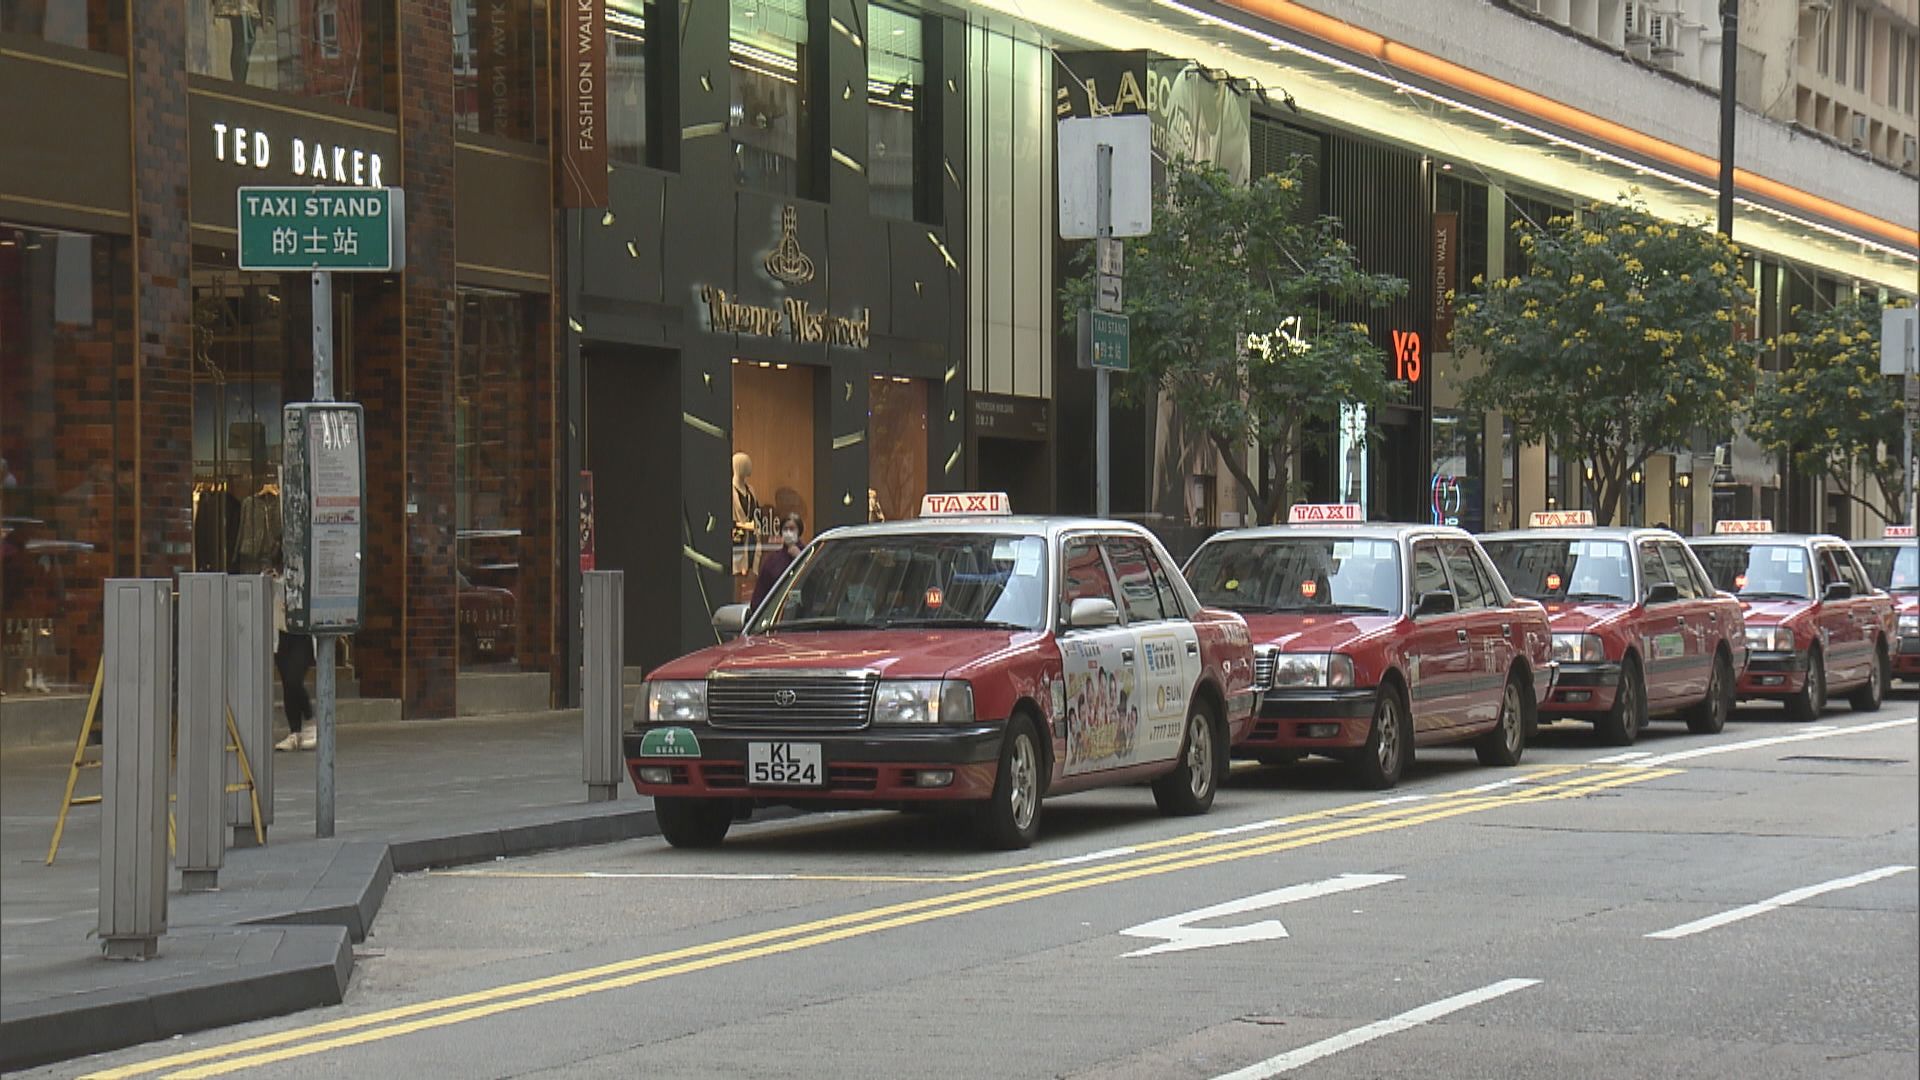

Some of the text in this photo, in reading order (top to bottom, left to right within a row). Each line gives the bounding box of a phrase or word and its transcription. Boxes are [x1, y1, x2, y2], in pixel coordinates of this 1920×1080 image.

[578, 0, 593, 151] FASHION WALK
[213, 123, 383, 189] TED BAKER
[246, 197, 382, 217] TAXI STAND
[272, 226, 358, 256] 的士站
[1436, 228, 1447, 320] FASHION WALK
[701, 283, 870, 349] Vivienne Westwood
[1094, 316, 1127, 337] TAXI STAND
[927, 494, 999, 514] TAXI
[1294, 506, 1354, 520] TAXI
[753, 507, 781, 537] Sale
[1535, 511, 1586, 526] TAXI
[1720, 521, 1766, 532] TAXI
[1886, 527, 1911, 535] TAXI
[1166, 685, 1181, 702] SUN
[664, 730, 676, 745] 4
[656, 746, 685, 755] SEATS
[770, 743, 801, 763] KL
[754, 763, 817, 783] 5624
